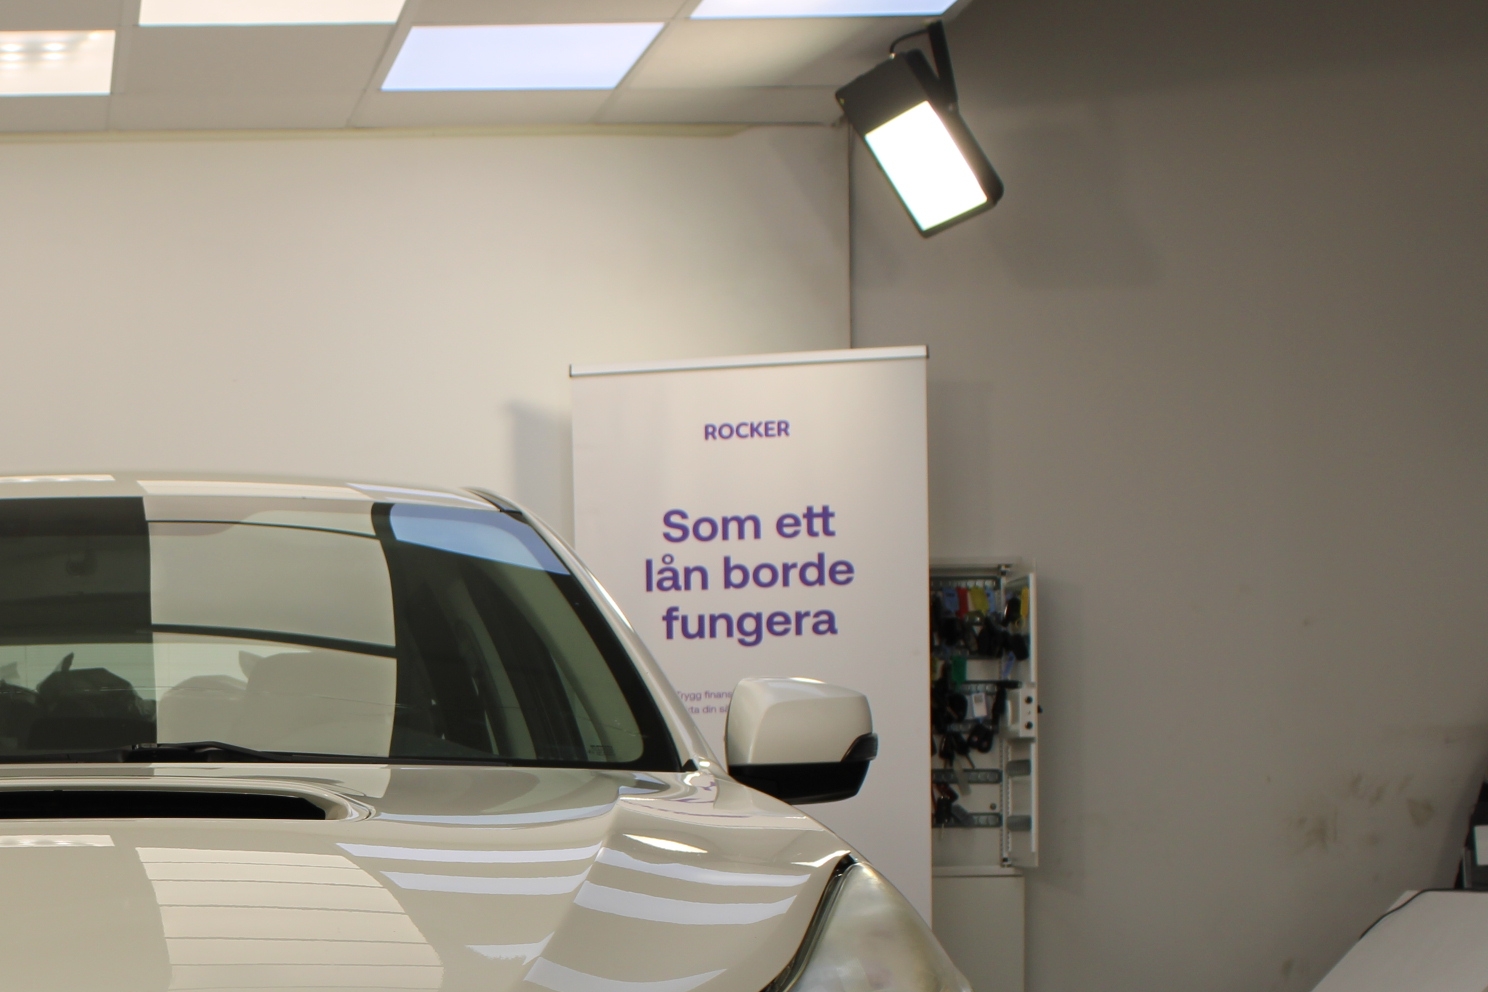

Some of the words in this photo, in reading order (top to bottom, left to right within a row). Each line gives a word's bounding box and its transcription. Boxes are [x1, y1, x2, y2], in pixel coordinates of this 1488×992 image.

[704, 420, 790, 441] ROCKER
[662, 508, 761, 542] Som
[775, 505, 836, 538] ett
[645, 553, 709, 592] lån
[723, 552, 855, 589] borde
[662, 606, 838, 647] fungera
